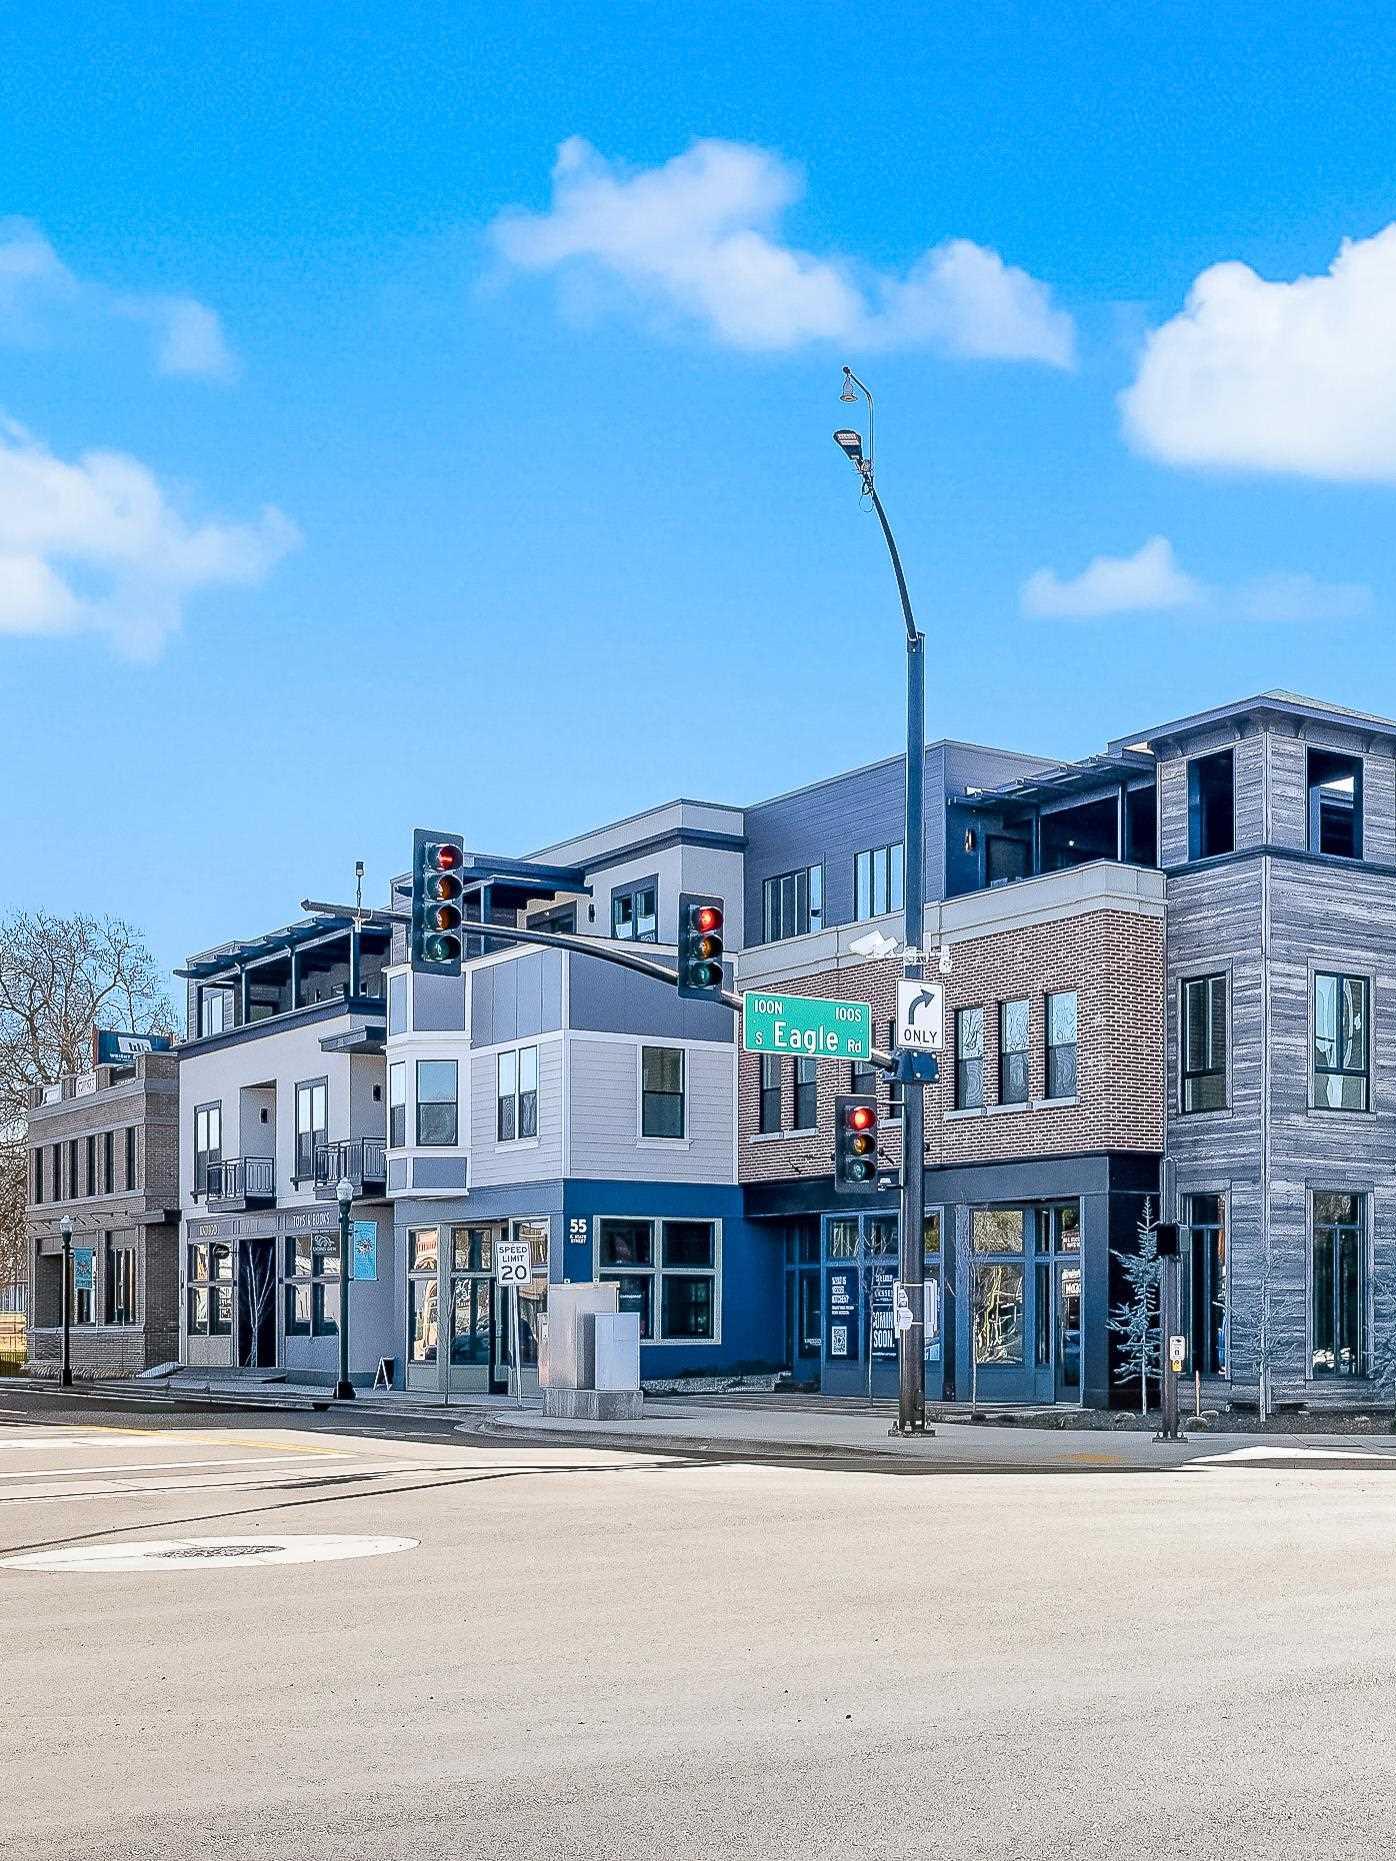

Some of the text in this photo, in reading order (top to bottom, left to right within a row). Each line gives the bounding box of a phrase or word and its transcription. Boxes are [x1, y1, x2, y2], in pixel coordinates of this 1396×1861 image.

[754, 999, 783, 1015] 100N
[835, 1006, 862, 1022] 100S
[755, 1020, 862, 1054] S Eagle Rd
[904, 1028, 938, 1044] ONLY
[569, 1219, 587, 1233] 55
[499, 1246, 527, 1254] SPEED
[502, 1254, 524, 1263] LIMIT
[501, 1265, 527, 1280] 20
[872, 1312, 894, 1329] COMIN
[873, 1329, 895, 1348] SOON.
